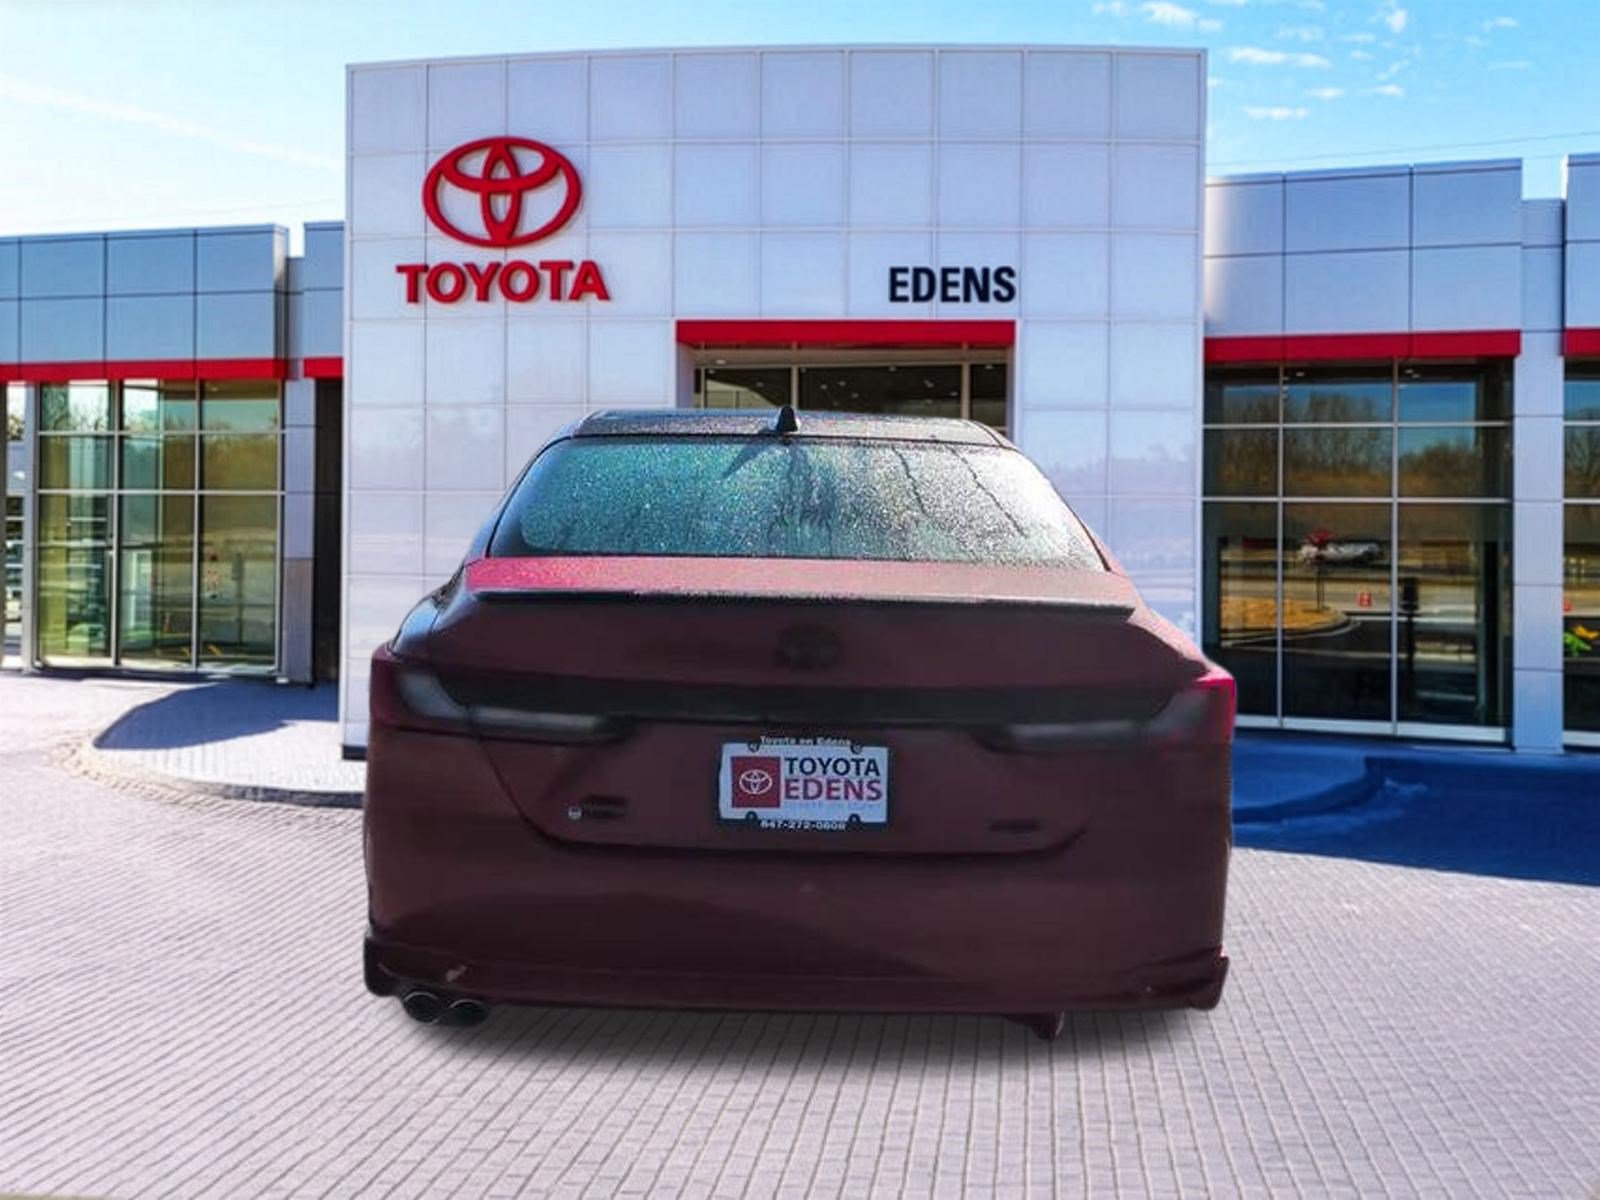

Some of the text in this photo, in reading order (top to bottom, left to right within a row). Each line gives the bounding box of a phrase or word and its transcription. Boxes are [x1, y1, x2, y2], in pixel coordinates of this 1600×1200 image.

[396, 260, 611, 304] TOYOTA
[889, 266, 1016, 303] EDENS
[784, 757, 881, 776] TOYOTA
[785, 778, 883, 801] EDENS
